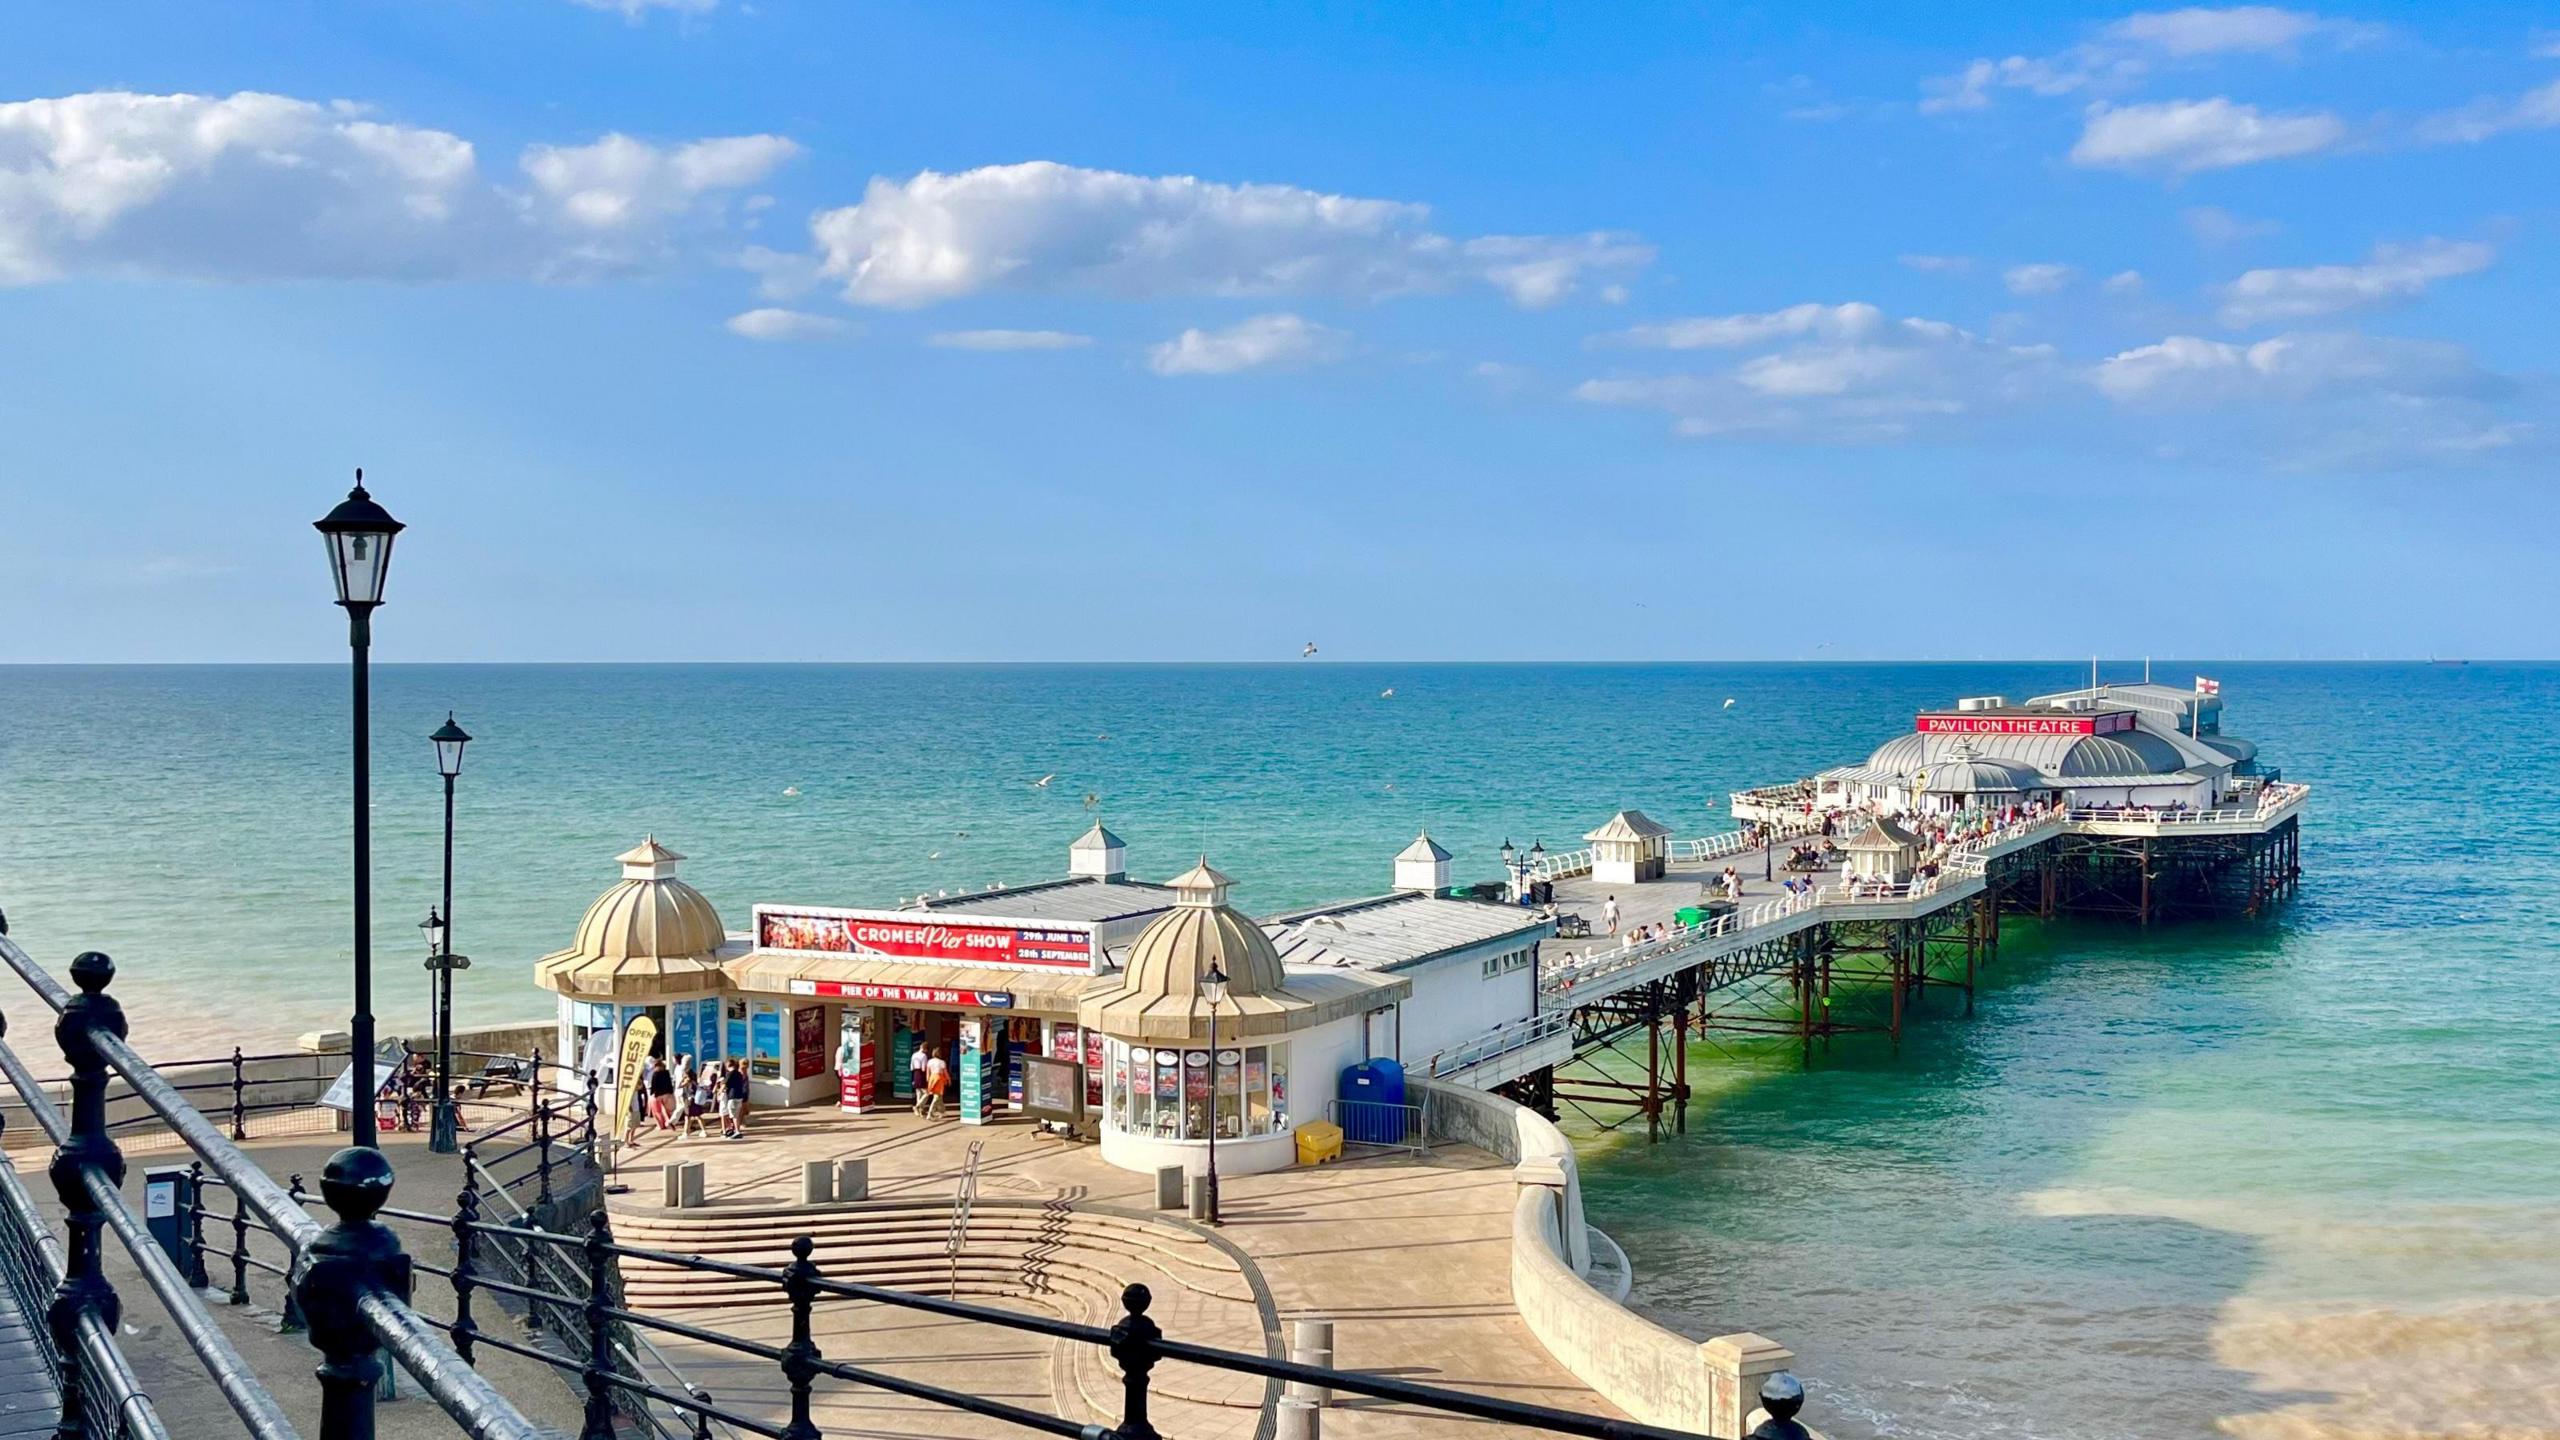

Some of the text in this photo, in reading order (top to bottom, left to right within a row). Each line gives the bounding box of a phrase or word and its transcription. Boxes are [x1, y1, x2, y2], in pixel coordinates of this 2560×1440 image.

[1929, 719, 2081, 733] PAVILION THEATRE
[857, 926, 1010, 949] CROMER Pier SHOW
[1023, 931, 1084, 943] 29th JUNE TO
[1018, 949, 1089, 961] 28th SEPTEMBER
[841, 985, 959, 1002] PIER OF THE YEAR 2024
[629, 1028, 653, 1039] OPEN
[621, 1041, 640, 1090] TIDES
